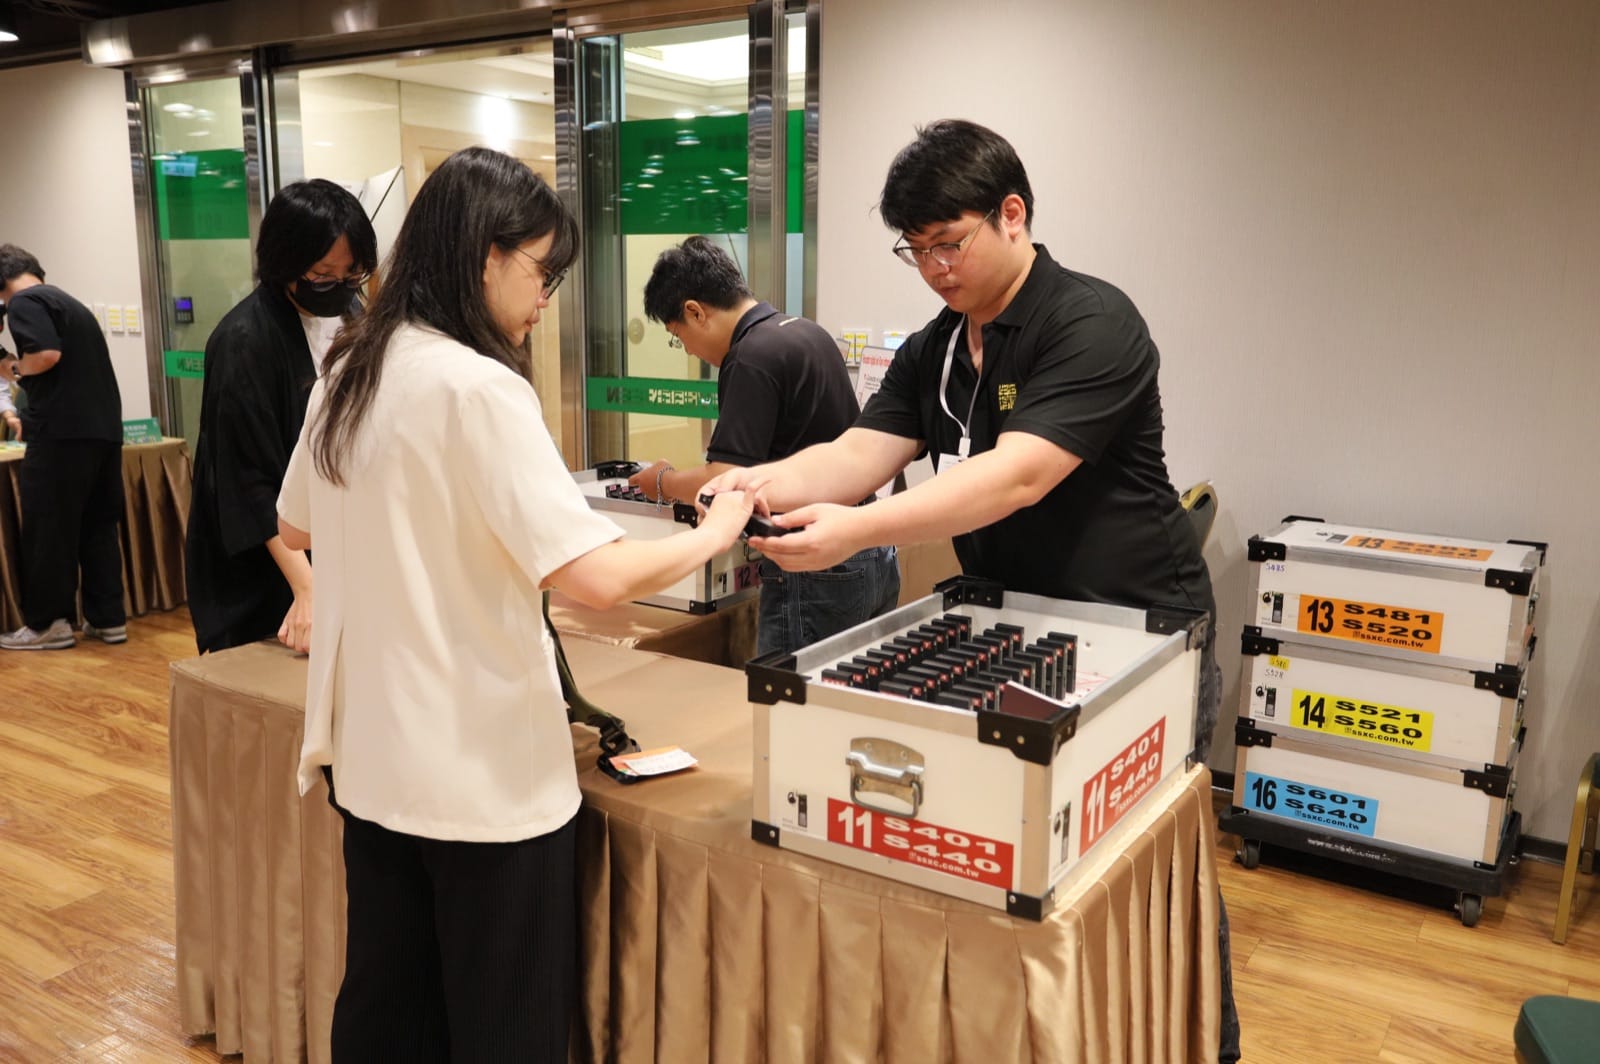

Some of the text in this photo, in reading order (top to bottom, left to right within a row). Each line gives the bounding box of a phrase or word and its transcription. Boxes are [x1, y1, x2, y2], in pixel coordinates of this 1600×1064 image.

[1356, 537, 1385, 549] 13
[1307, 599, 1334, 633] 13
[1342, 618, 1432, 641] S520
[1343, 603, 1430, 625] S481
[1299, 694, 1326, 729] 14
[1334, 714, 1423, 739] S560
[1335, 700, 1420, 724] S521
[1110, 726, 1160, 782] S401
[1108, 751, 1160, 809] S440
[1252, 777, 1277, 811] 16
[1286, 784, 1367, 810] S601
[1086, 771, 1107, 843] 11
[1284, 798, 1368, 824] S640
[837, 805, 873, 849] 11
[883, 816, 997, 856] S401
[883, 833, 1002, 874] S440
